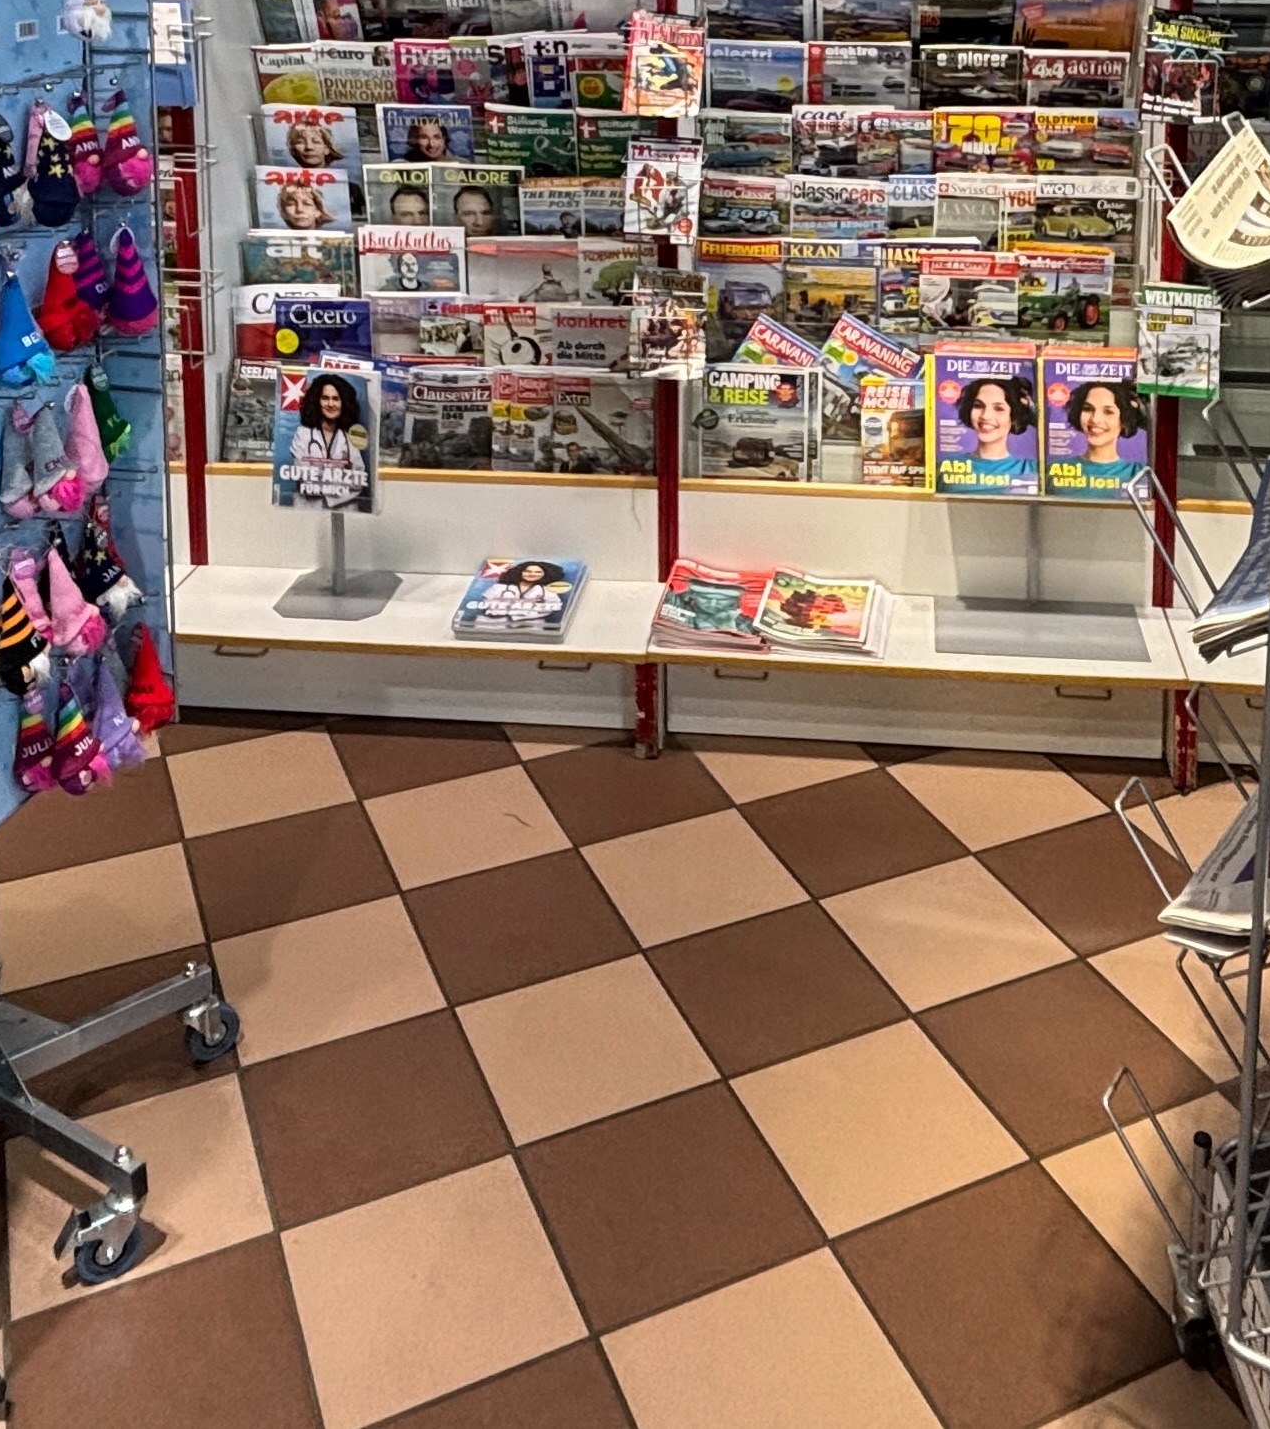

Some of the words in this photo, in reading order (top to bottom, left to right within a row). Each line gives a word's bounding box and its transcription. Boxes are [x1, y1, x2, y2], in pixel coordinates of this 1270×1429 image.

[259, 54, 305, 68] Capital
[273, 109, 345, 127] arte
[264, 169, 338, 188] arte
[444, 170, 509, 186] GALORE
[265, 237, 323, 259] art
[701, 241, 779, 257] FEUERWEHR
[790, 244, 841, 258] KRAN
[1145, 290, 1221, 309] WELTKRIEG
[290, 303, 357, 325] Cicero
[557, 311, 627, 330] konkret
[557, 342, 572, 351] Ab
[575, 341, 605, 351] durch
[837, 320, 915, 374] CARAVANING
[556, 351, 572, 361] die
[574, 351, 606, 361] Mitte
[946, 359, 972, 372] DIE
[991, 360, 1022, 374] ZEIT
[1055, 362, 1081, 376] DIE
[1100, 363, 1133, 378] ZEIT
[708, 371, 781, 390] CAMPING
[413, 384, 491, 402] Clausewitz
[557, 393, 590, 406] Extra
[723, 388, 770, 405] REISE
[865, 386, 911, 399] REISE
[863, 397, 911, 410] MOBIL
[279, 464, 320, 482] GUTE
[940, 460, 972, 474] Abi
[1050, 463, 1082, 477] Abi
[944, 472, 977, 486] und
[980, 473, 1010, 487] los!
[1054, 475, 1086, 489] und
[1090, 476, 1120, 489] los!
[300, 482, 321, 496] FÜR
